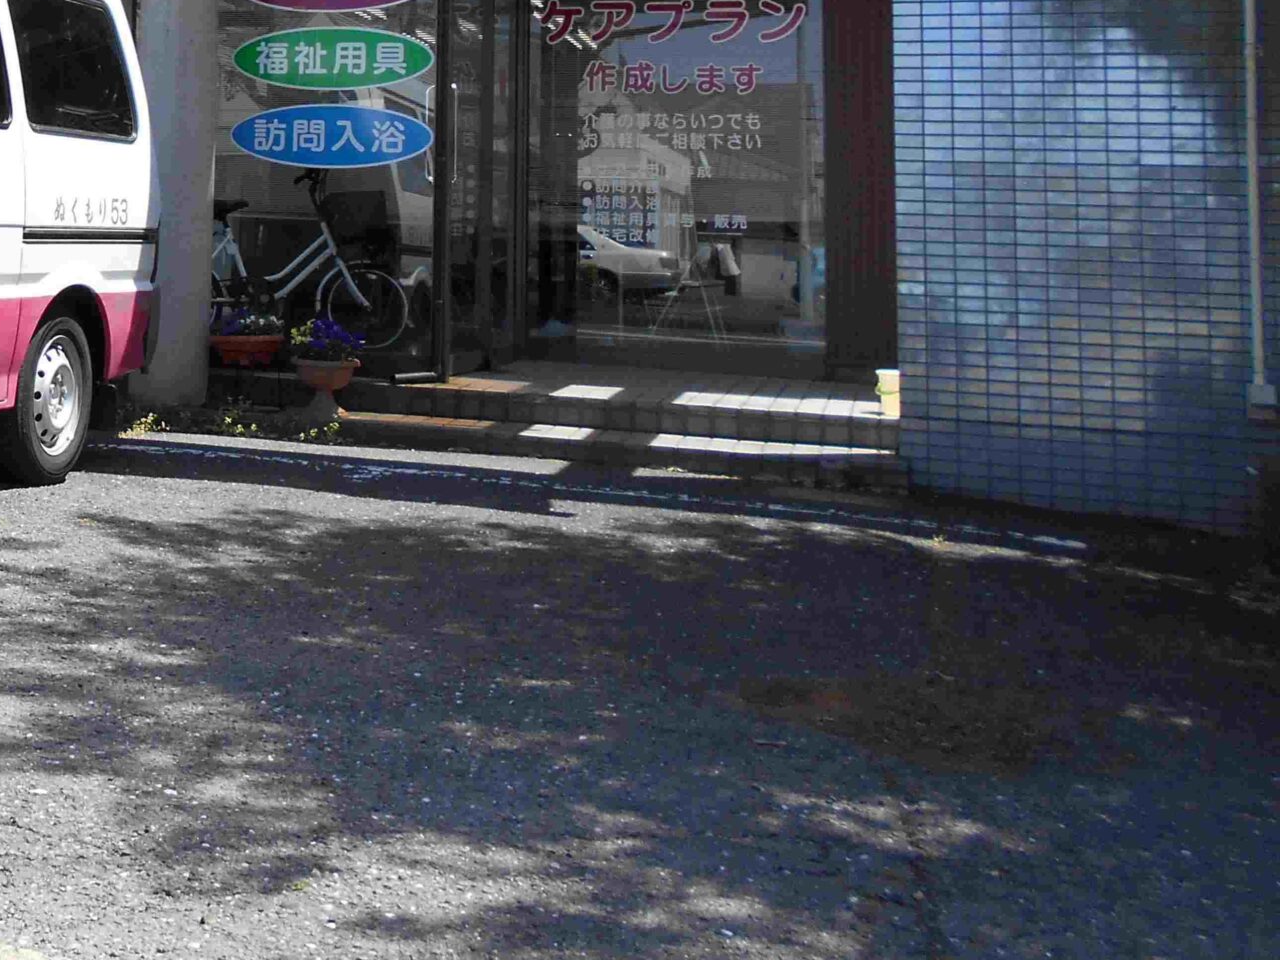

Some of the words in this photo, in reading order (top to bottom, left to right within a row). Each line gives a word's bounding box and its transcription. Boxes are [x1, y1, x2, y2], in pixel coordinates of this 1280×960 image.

[256, 41, 408, 76] 福祉用具
[585, 60, 763, 95] 作成します
[253, 118, 407, 154] 訪問入浴
[54, 196, 128, 225] ぬくもり53
